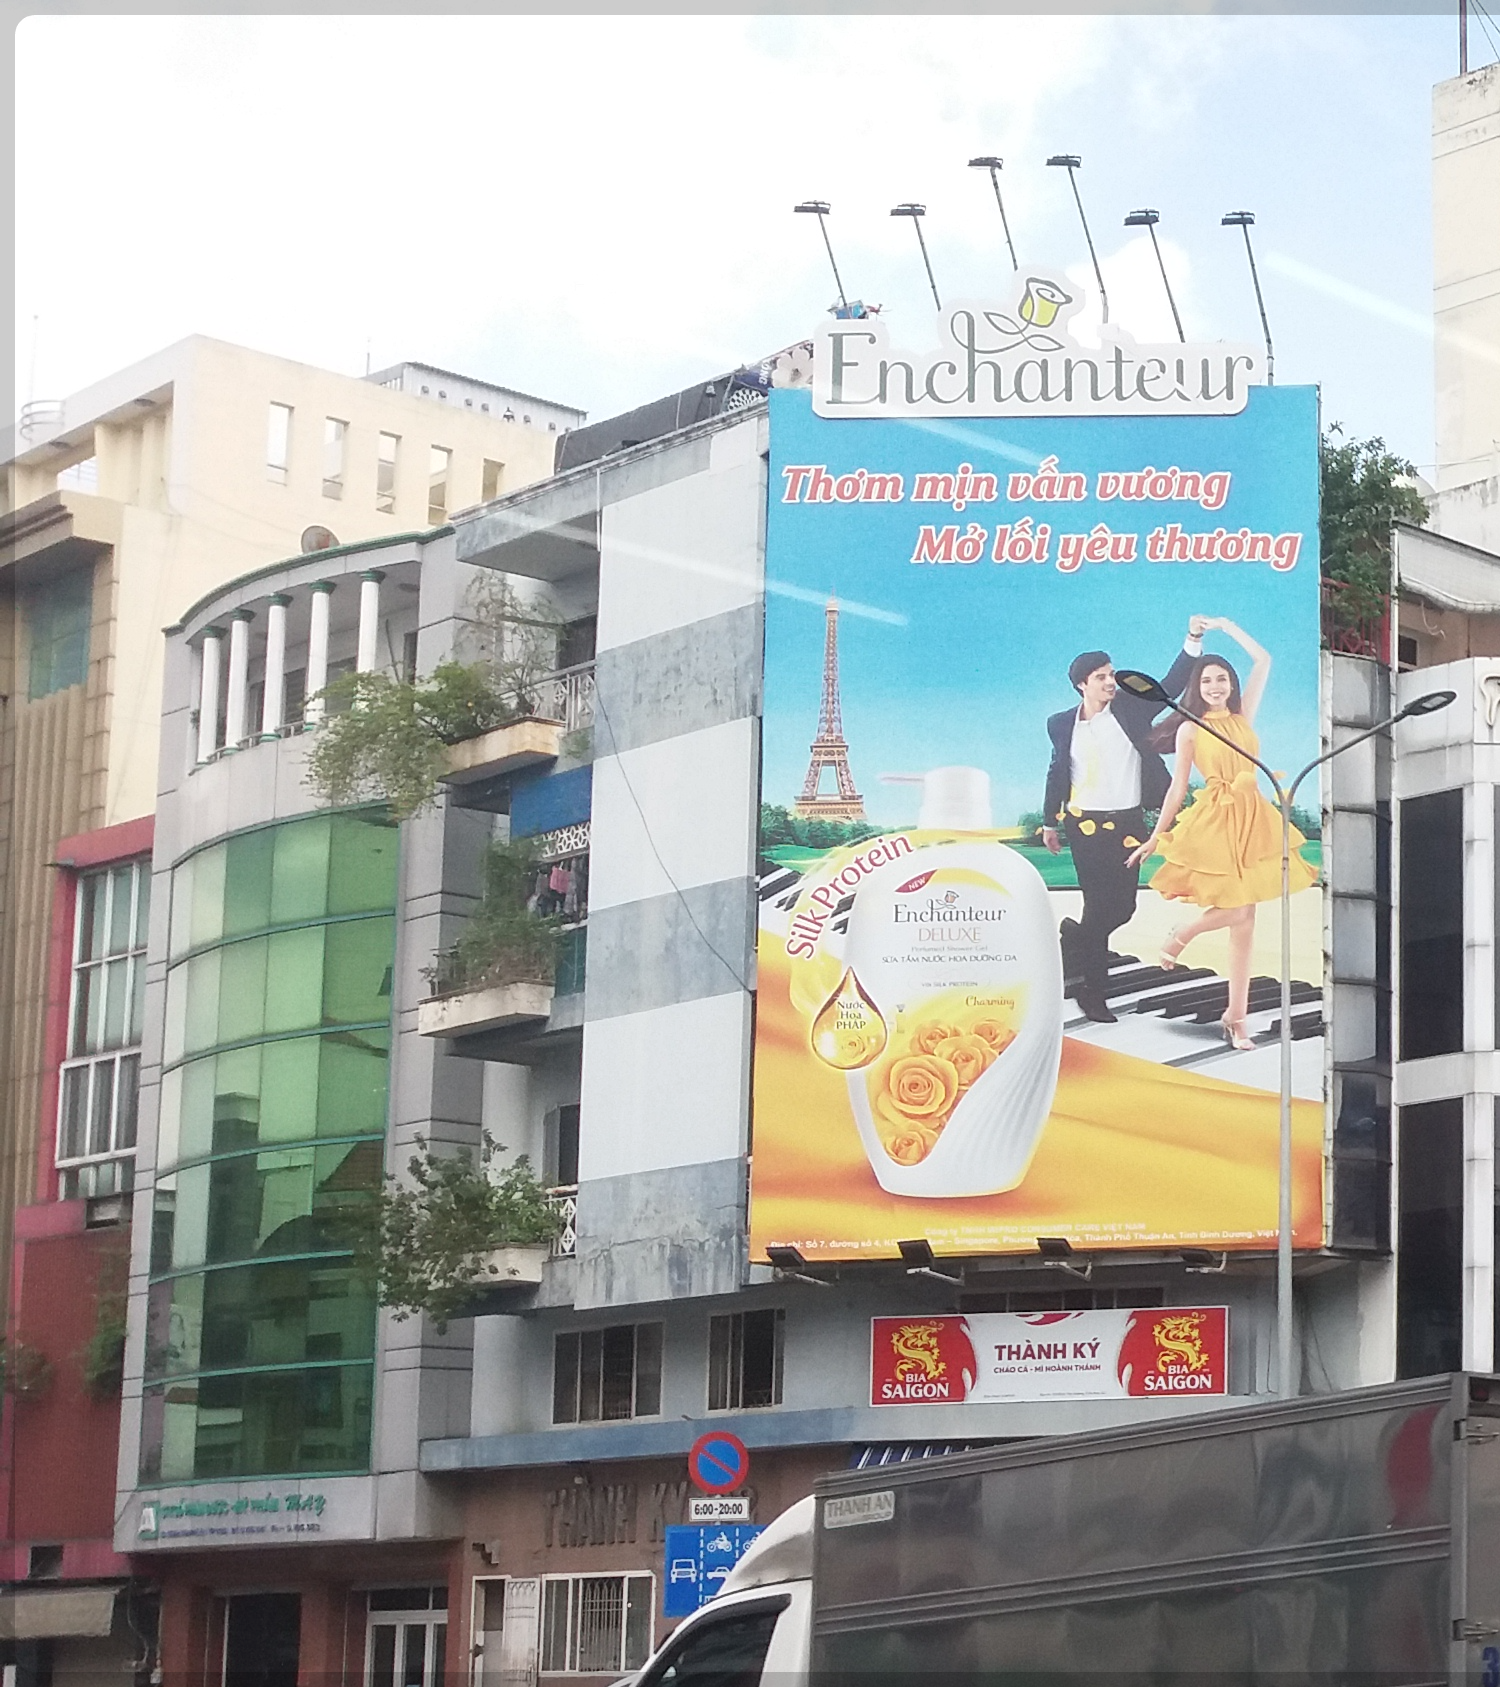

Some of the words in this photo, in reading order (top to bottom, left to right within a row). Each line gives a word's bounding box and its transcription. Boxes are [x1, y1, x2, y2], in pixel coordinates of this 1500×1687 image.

[826, 311, 1254, 403] Enchanteur
[783, 465, 902, 503] Thơm
[912, 463, 997, 510] mịn
[1008, 455, 1086, 501] vấn
[1097, 465, 1231, 510] vương
[912, 523, 986, 565] Mở
[993, 517, 1050, 563] lối
[1056, 526, 1136, 573] yêu
[1147, 529, 1301, 572] thương
[907, 877, 926, 891] NEW
[786, 908, 830, 959] Silk
[810, 836, 914, 909] Protein
[894, 899, 1006, 923] Enchanteur
[918, 927, 981, 943] DELUXE
[837, 1001, 865, 1009] Nước
[965, 995, 1015, 1010] Charming
[840, 1011, 862, 1019] Hoa
[836, 1019, 866, 1029] PHÁP
[994, 1338, 1067, 1361] THÀNH
[1072, 1337, 1101, 1359] KÝ
[906, 1373, 927, 1382] BIA
[1168, 1365, 1189, 1374] BIA
[1144, 1374, 1212, 1391] SAIGON
[882, 1383, 949, 1399] SAIGON
[694, 1504, 743, 1516] 6:00-20:00
